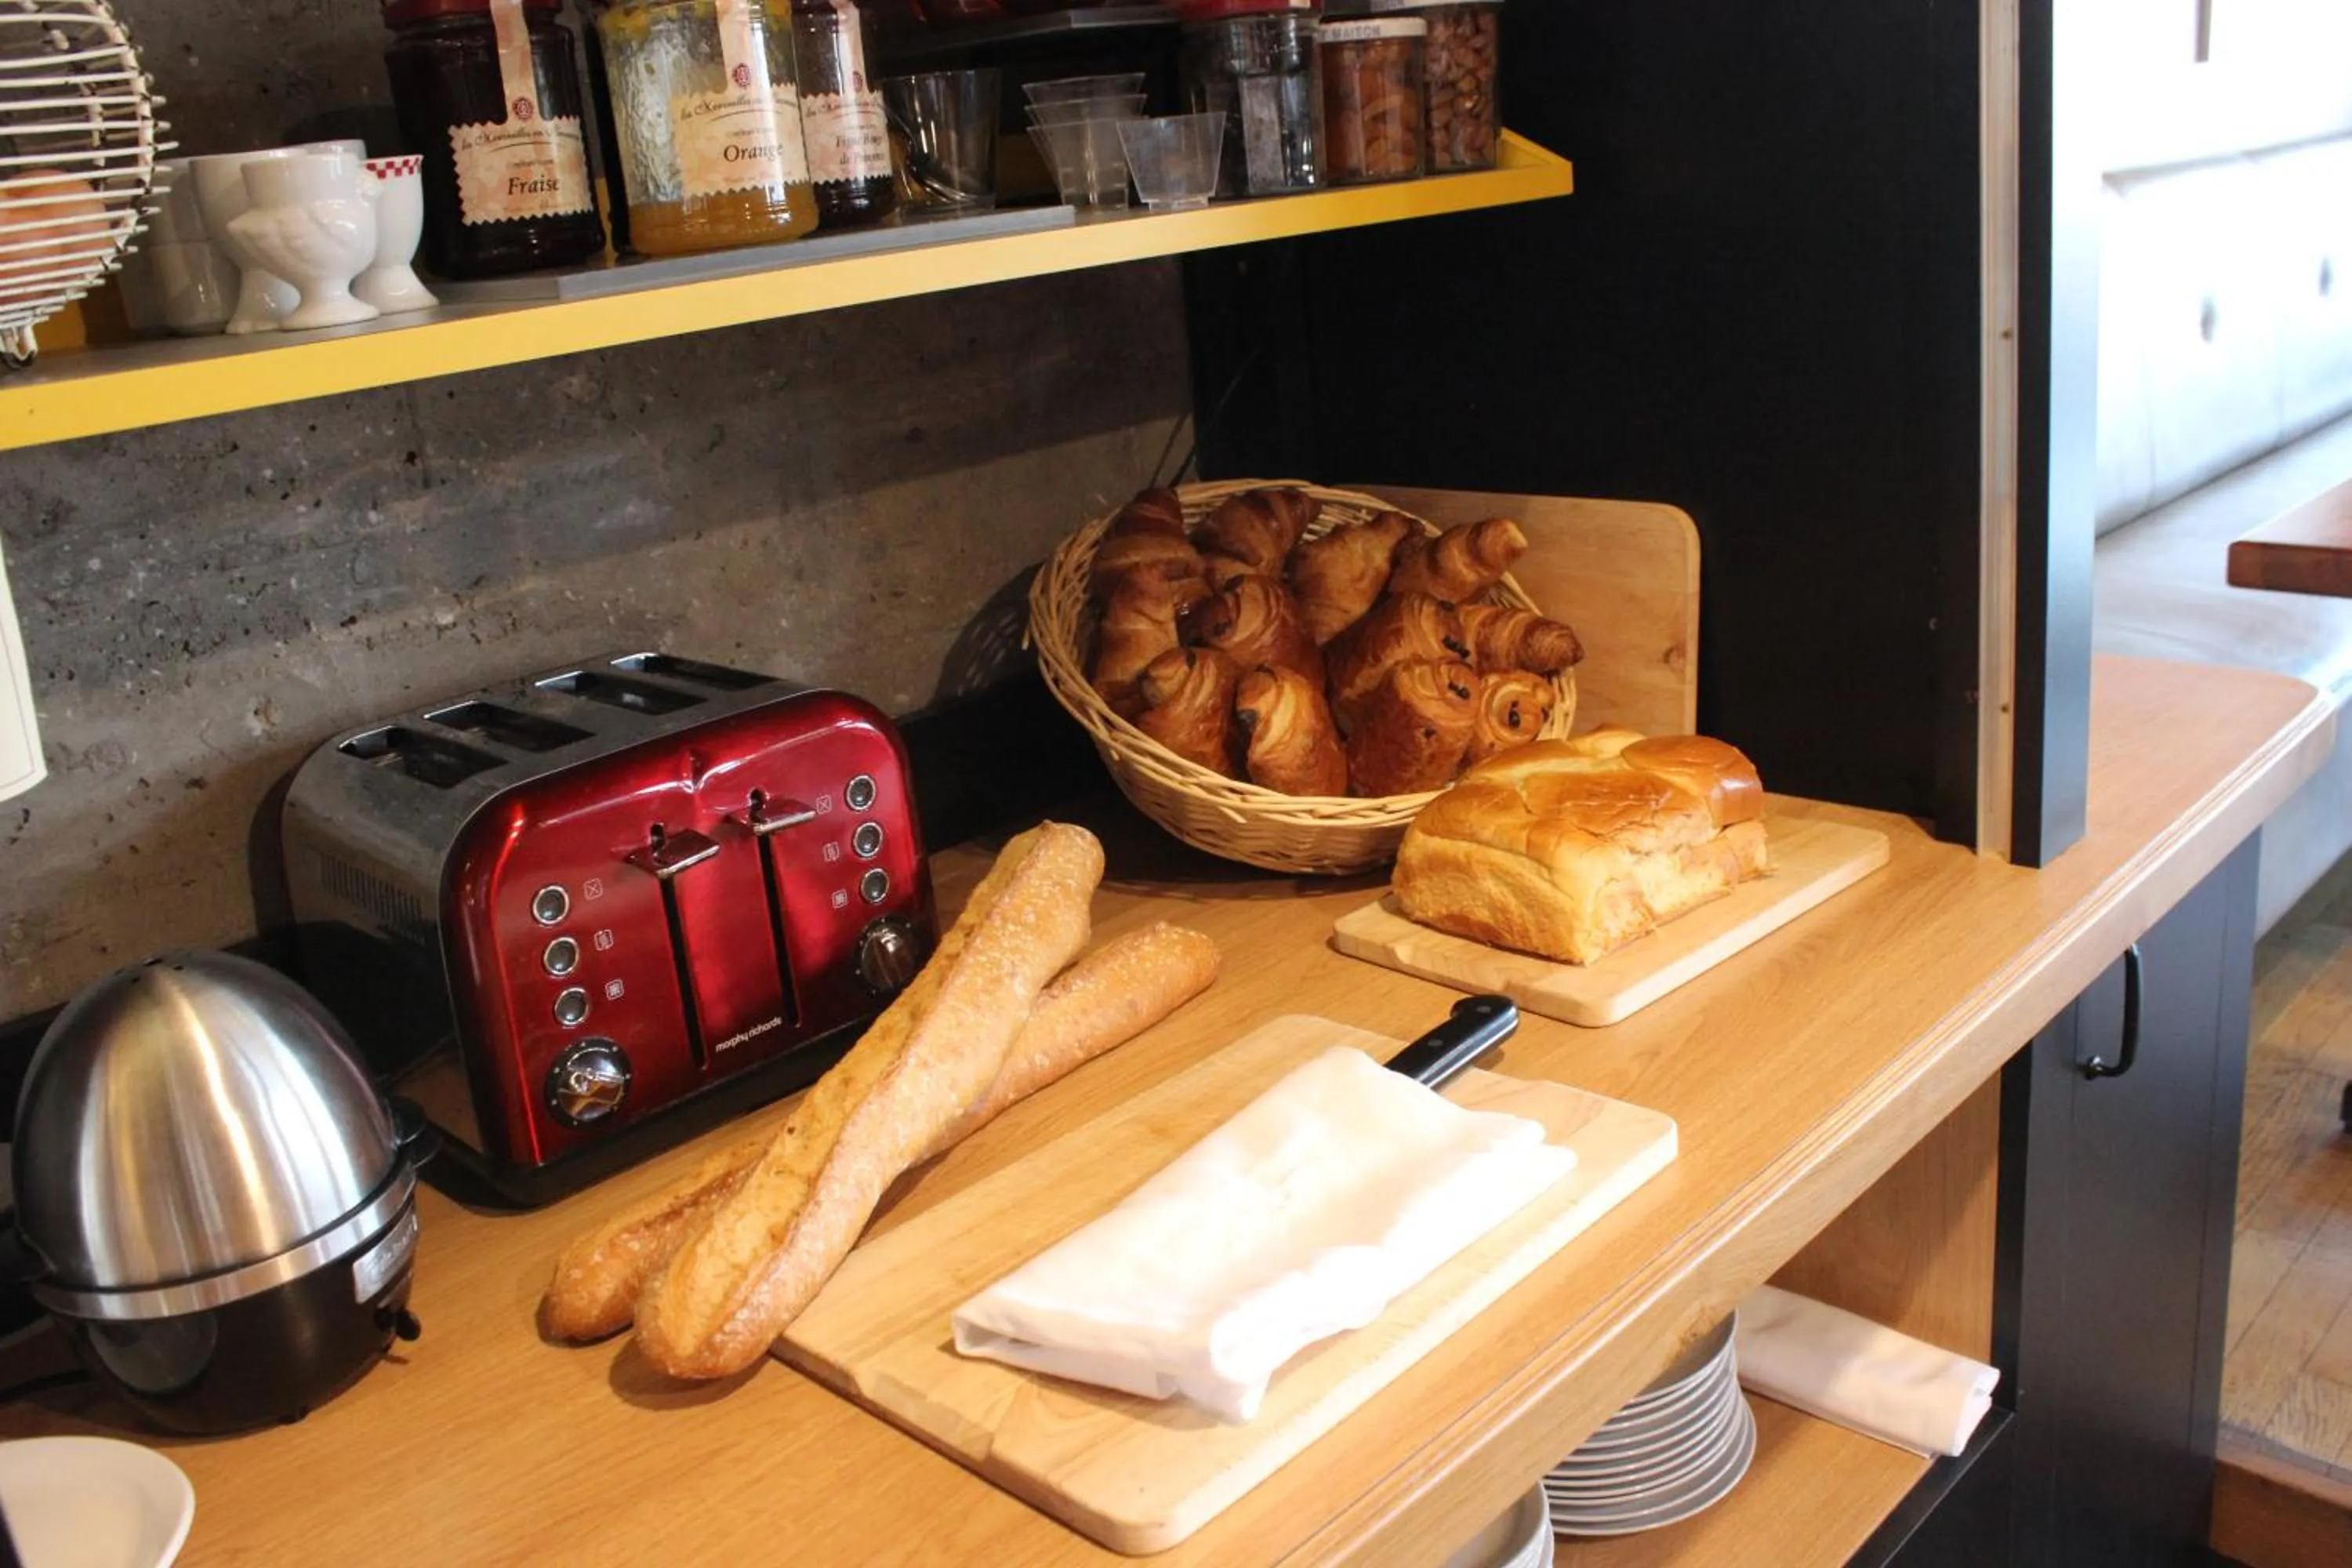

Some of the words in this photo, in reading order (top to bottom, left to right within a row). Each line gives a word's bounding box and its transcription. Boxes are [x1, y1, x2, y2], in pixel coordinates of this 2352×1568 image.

[724, 143, 783, 162] Orange
[508, 175, 560, 195] Fraise
[715, 1033, 749, 1053] morphy
[749, 1017, 782, 1037] richards
